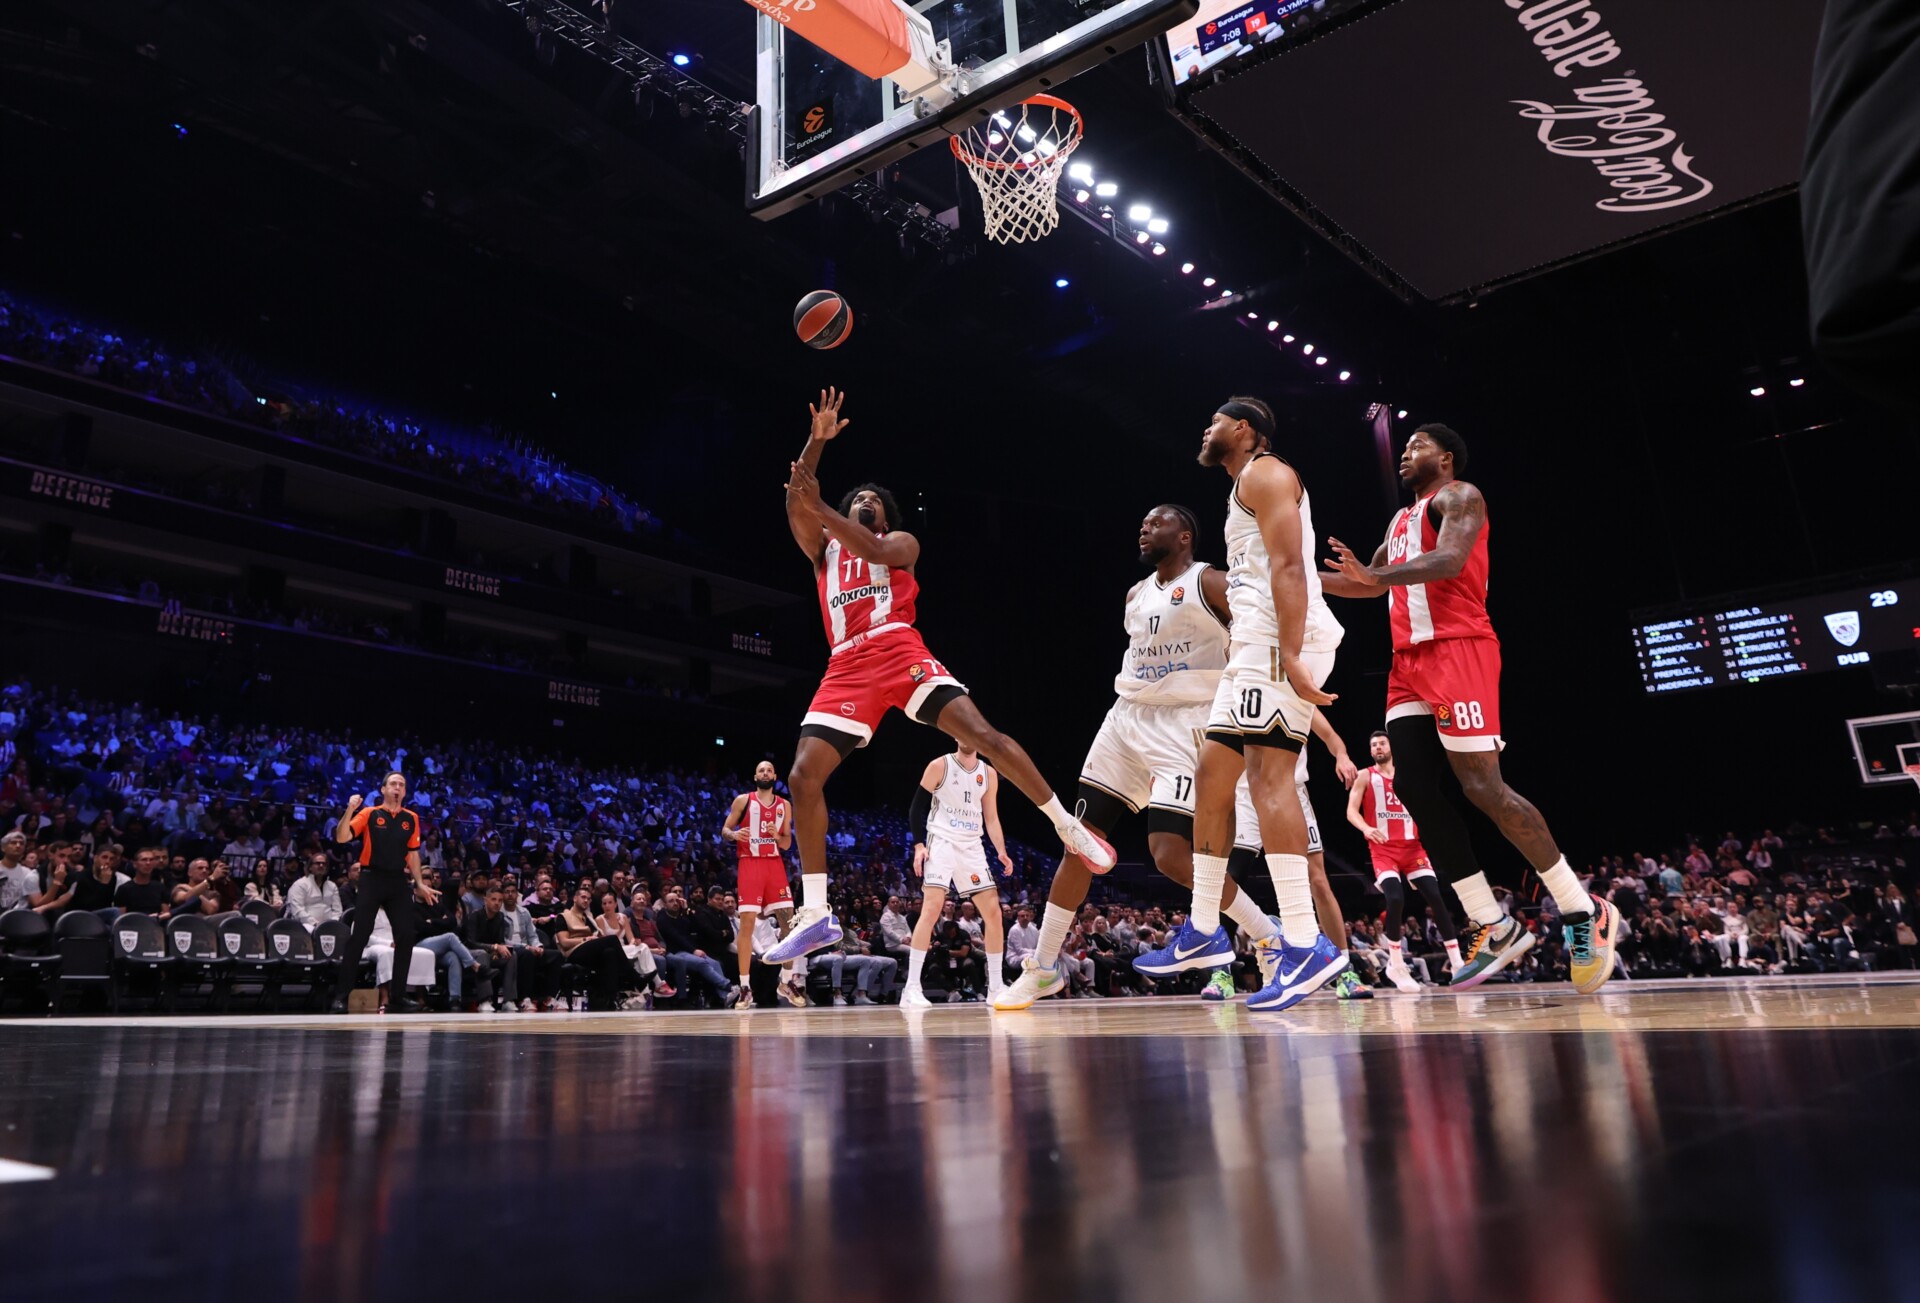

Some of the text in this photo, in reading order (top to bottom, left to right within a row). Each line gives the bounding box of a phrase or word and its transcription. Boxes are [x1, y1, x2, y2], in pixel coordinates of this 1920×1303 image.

[1217, 6, 1254, 28] EuroLeague
[1250, 18, 1261, 29] 19
[1221, 27, 1241, 43] 7:08
[1504, 0, 1714, 212] Coca-Cola aren
[796, 127, 833, 150] EuroLeague
[30, 471, 113, 509] DEFENSE
[1390, 534, 1406, 562] 88
[445, 567, 501, 597] DEFENSE
[830, 583, 889, 608] 00xronia
[1870, 590, 1898, 607] 29
[1149, 615, 1160, 635] 17
[732, 633, 773, 657] DEFENSE
[1131, 641, 1192, 658] OMNIYAT
[1136, 660, 1188, 680] dnata
[1836, 651, 1870, 666] DUB
[548, 680, 601, 707] DEFENSE
[1240, 687, 1262, 719] 10
[1453, 700, 1485, 731] 88
[1174, 774, 1193, 802] 17
[947, 806, 982, 820] OMNIYA
[949, 818, 979, 832] dnata
